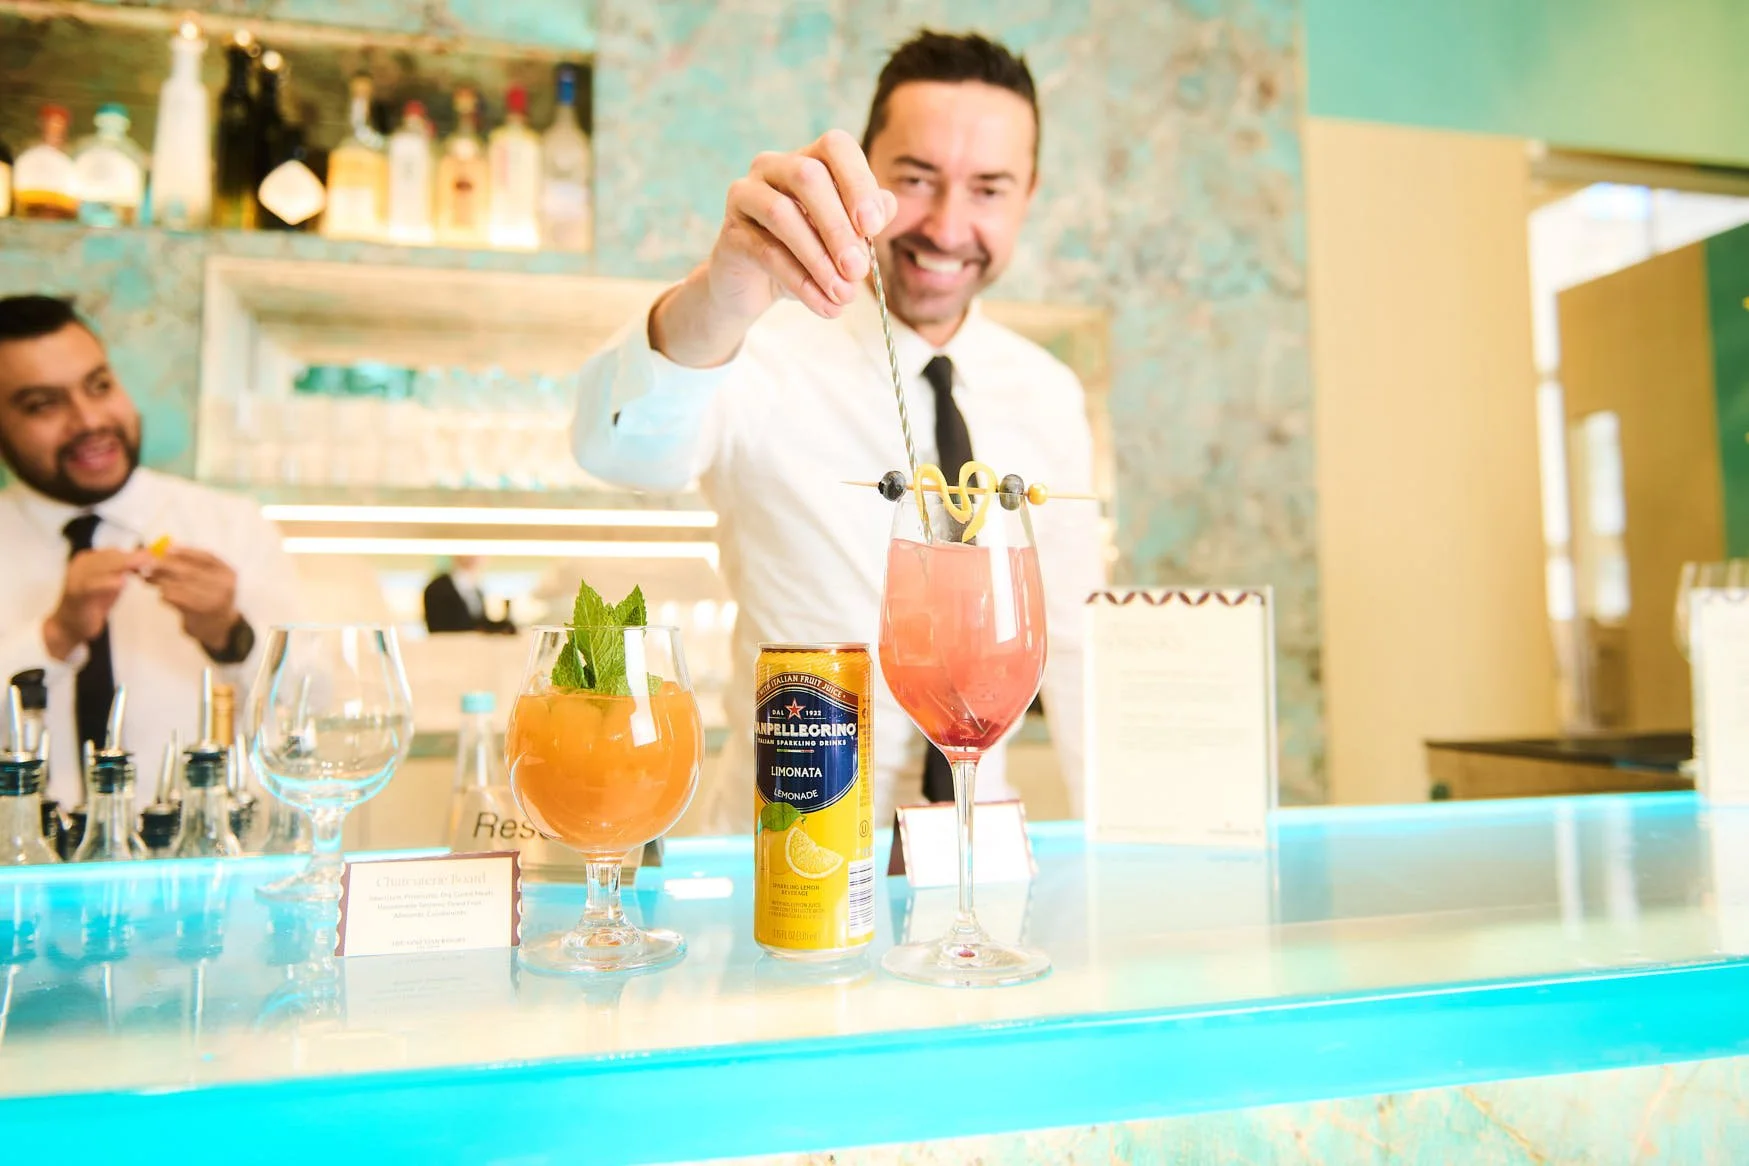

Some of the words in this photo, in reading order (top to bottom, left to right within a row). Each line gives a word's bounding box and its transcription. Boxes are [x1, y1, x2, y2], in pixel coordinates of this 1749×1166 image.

[771, 675, 799, 687] ITALIAN
[800, 675, 822, 688] FRUIT
[822, 683, 842, 698] JUICE
[755, 722, 857, 737] ANPELLEGRINO
[771, 766, 823, 778] LIMONATA
[773, 788, 819, 800] LEMONADE
[473, 812, 549, 840] Res
